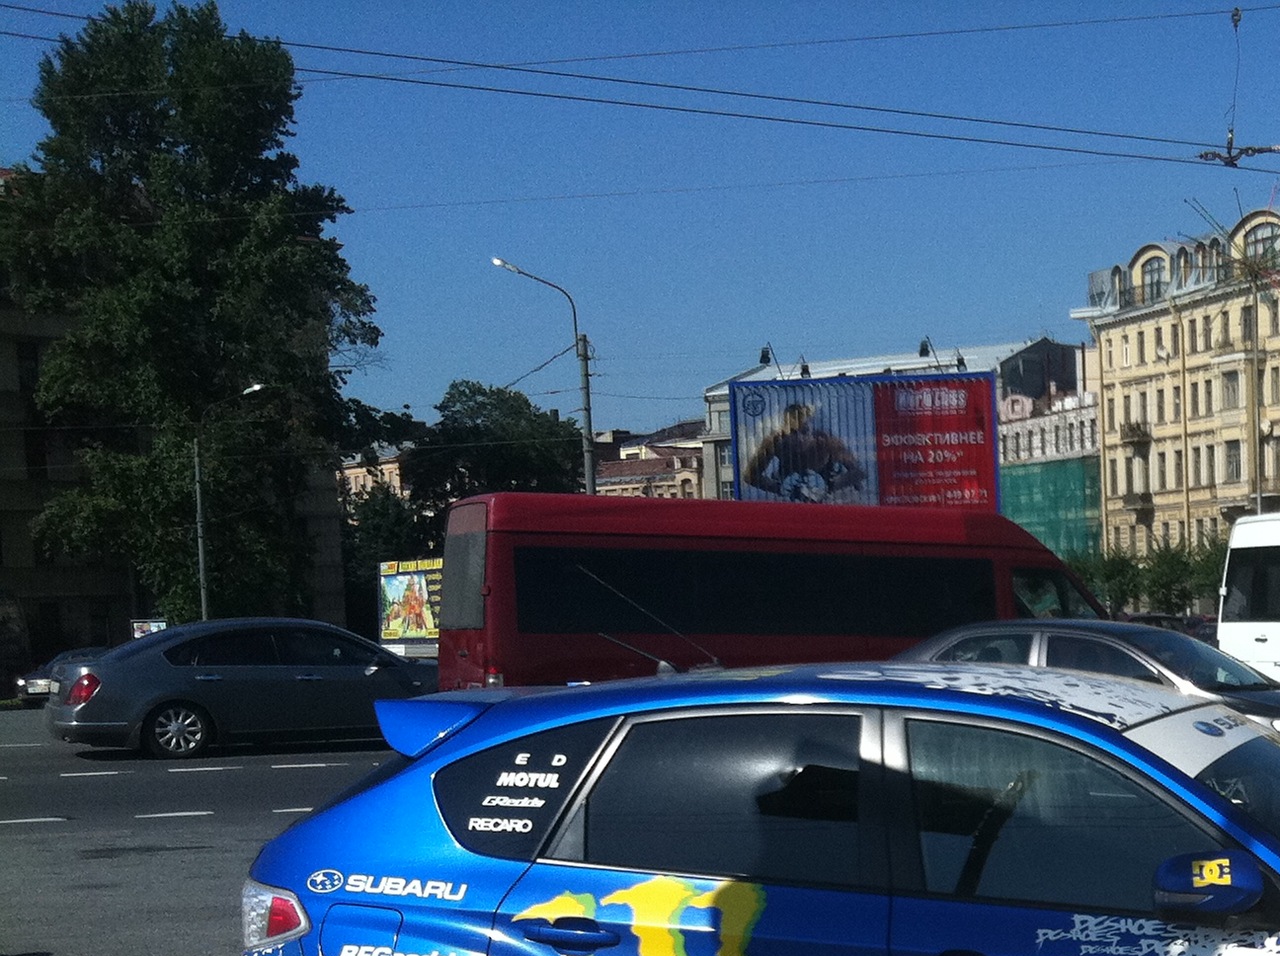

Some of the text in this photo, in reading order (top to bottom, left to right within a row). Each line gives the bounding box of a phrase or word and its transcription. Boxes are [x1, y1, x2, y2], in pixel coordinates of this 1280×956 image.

[496, 772, 560, 788] MOTUL
[468, 817, 533, 833] RECARO
[345, 874, 467, 901] SUBARU
